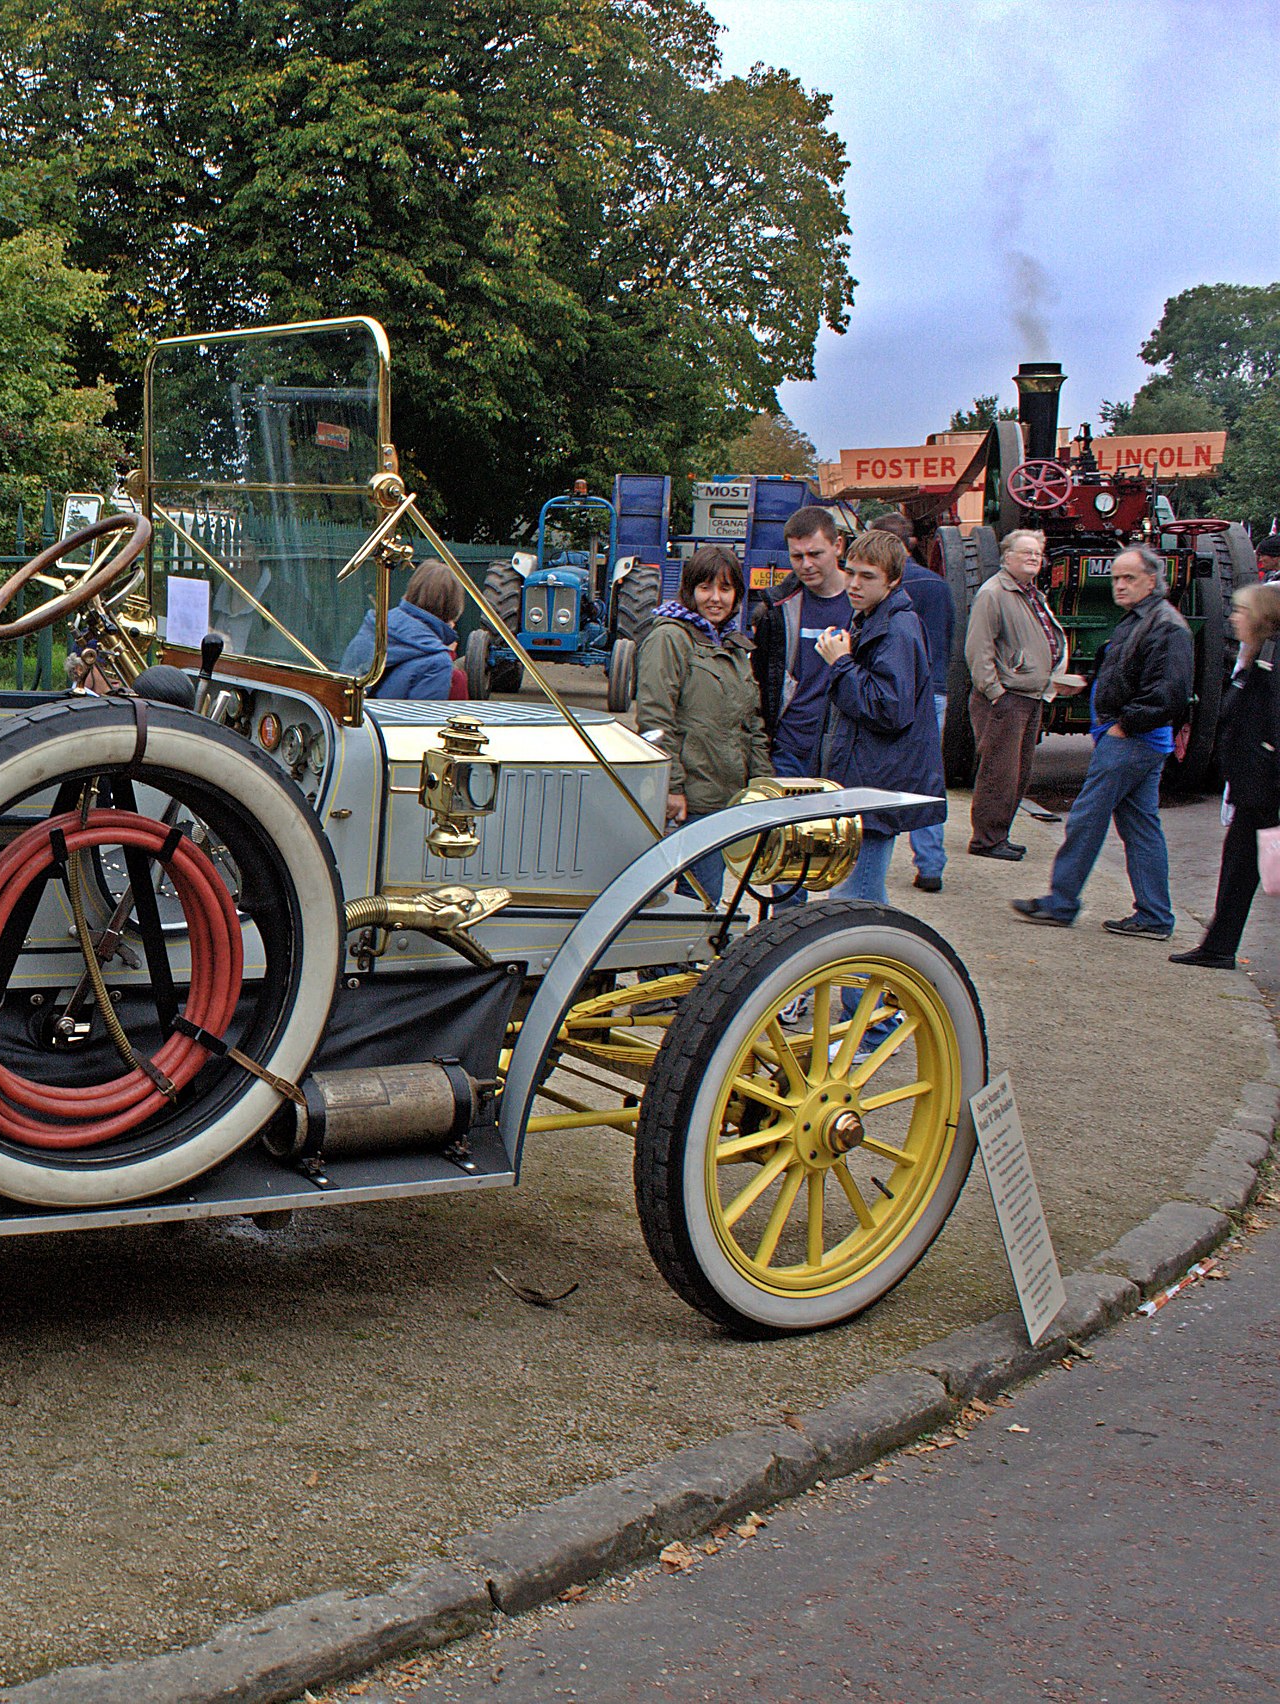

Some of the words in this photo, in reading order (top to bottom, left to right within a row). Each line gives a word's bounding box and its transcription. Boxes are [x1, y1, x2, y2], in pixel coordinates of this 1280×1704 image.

[856, 457, 956, 480] FOSTER
[1097, 445, 1212, 471] LINCOLN
[760, 572, 784, 580] LONG
